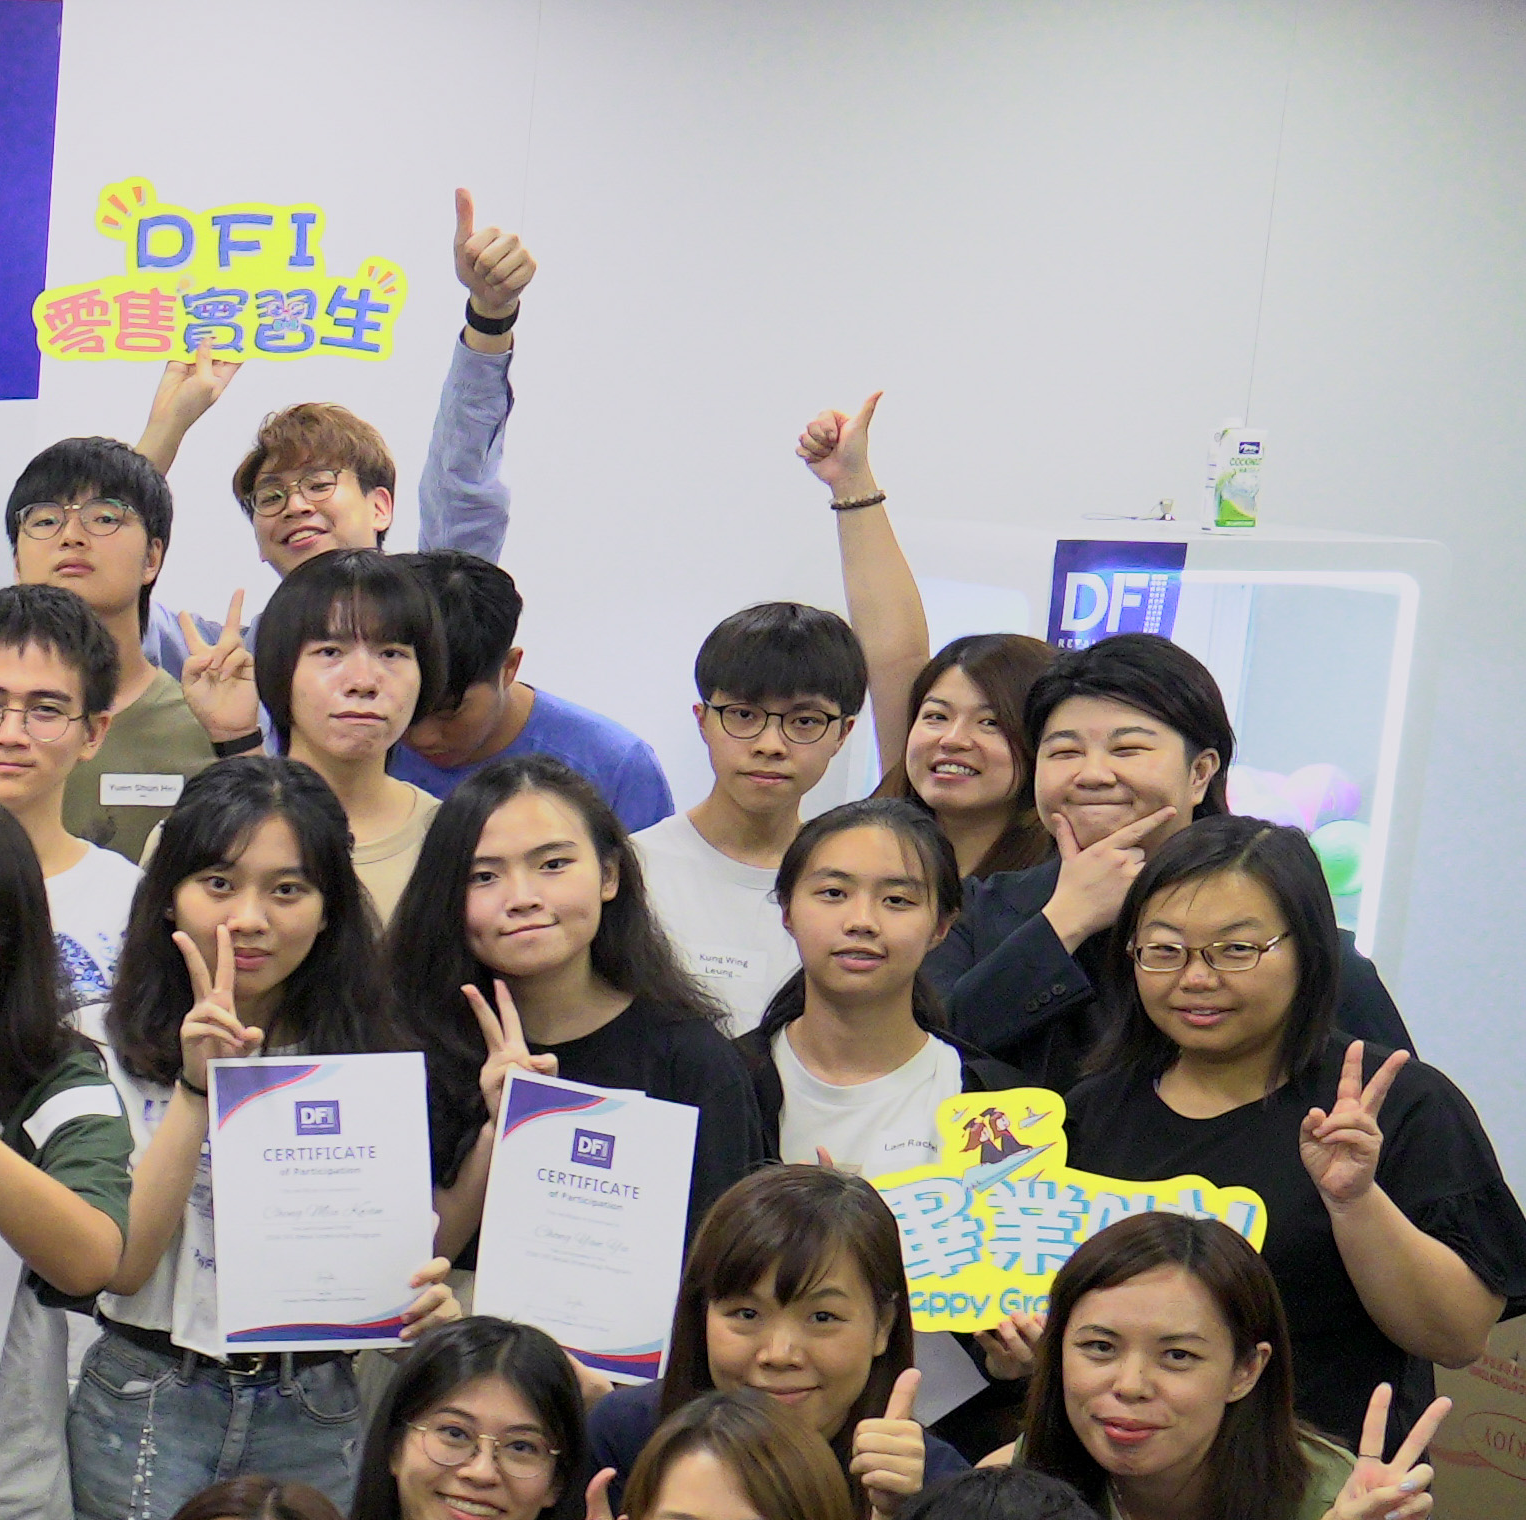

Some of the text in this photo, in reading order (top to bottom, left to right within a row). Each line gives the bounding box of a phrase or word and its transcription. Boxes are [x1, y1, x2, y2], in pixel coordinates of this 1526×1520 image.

[136, 212, 318, 270] DFI
[41, 287, 400, 357] 零售實習生
[1060, 572, 1169, 633] DFI
[300, 1106, 334, 1125] DFI
[263, 1145, 376, 1161] CERTIFICATE
[577, 1135, 608, 1157] DFI
[537, 1167, 641, 1199] CERTIFICATE
[908, 1290, 990, 1318] appy
